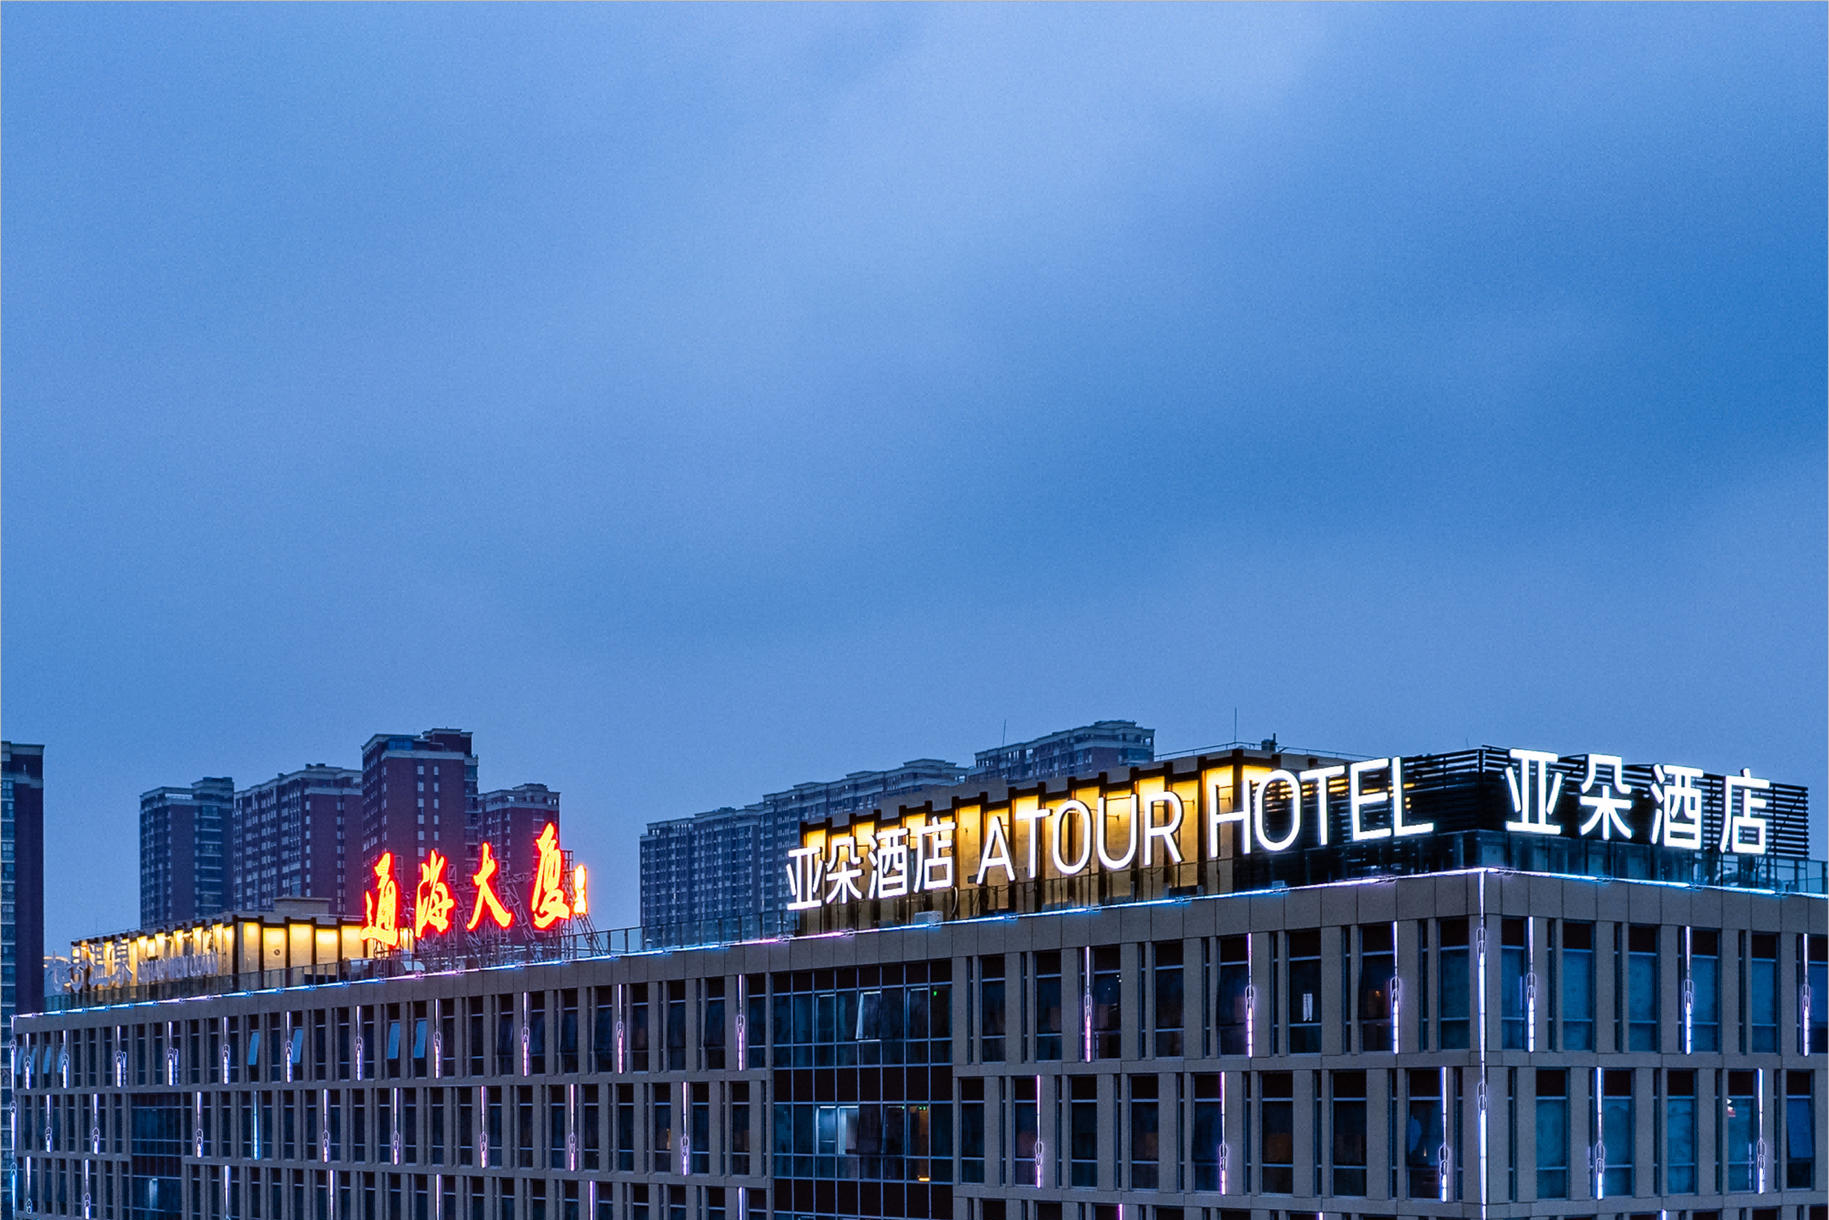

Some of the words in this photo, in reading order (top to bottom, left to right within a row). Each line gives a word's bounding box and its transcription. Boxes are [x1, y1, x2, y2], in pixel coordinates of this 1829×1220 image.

[786, 815, 957, 911] 亚朵酒店
[976, 790, 1183, 886] ATOUR
[1207, 756, 1435, 858] HOTEL
[1504, 748, 1771, 855] 亚朵酒店
